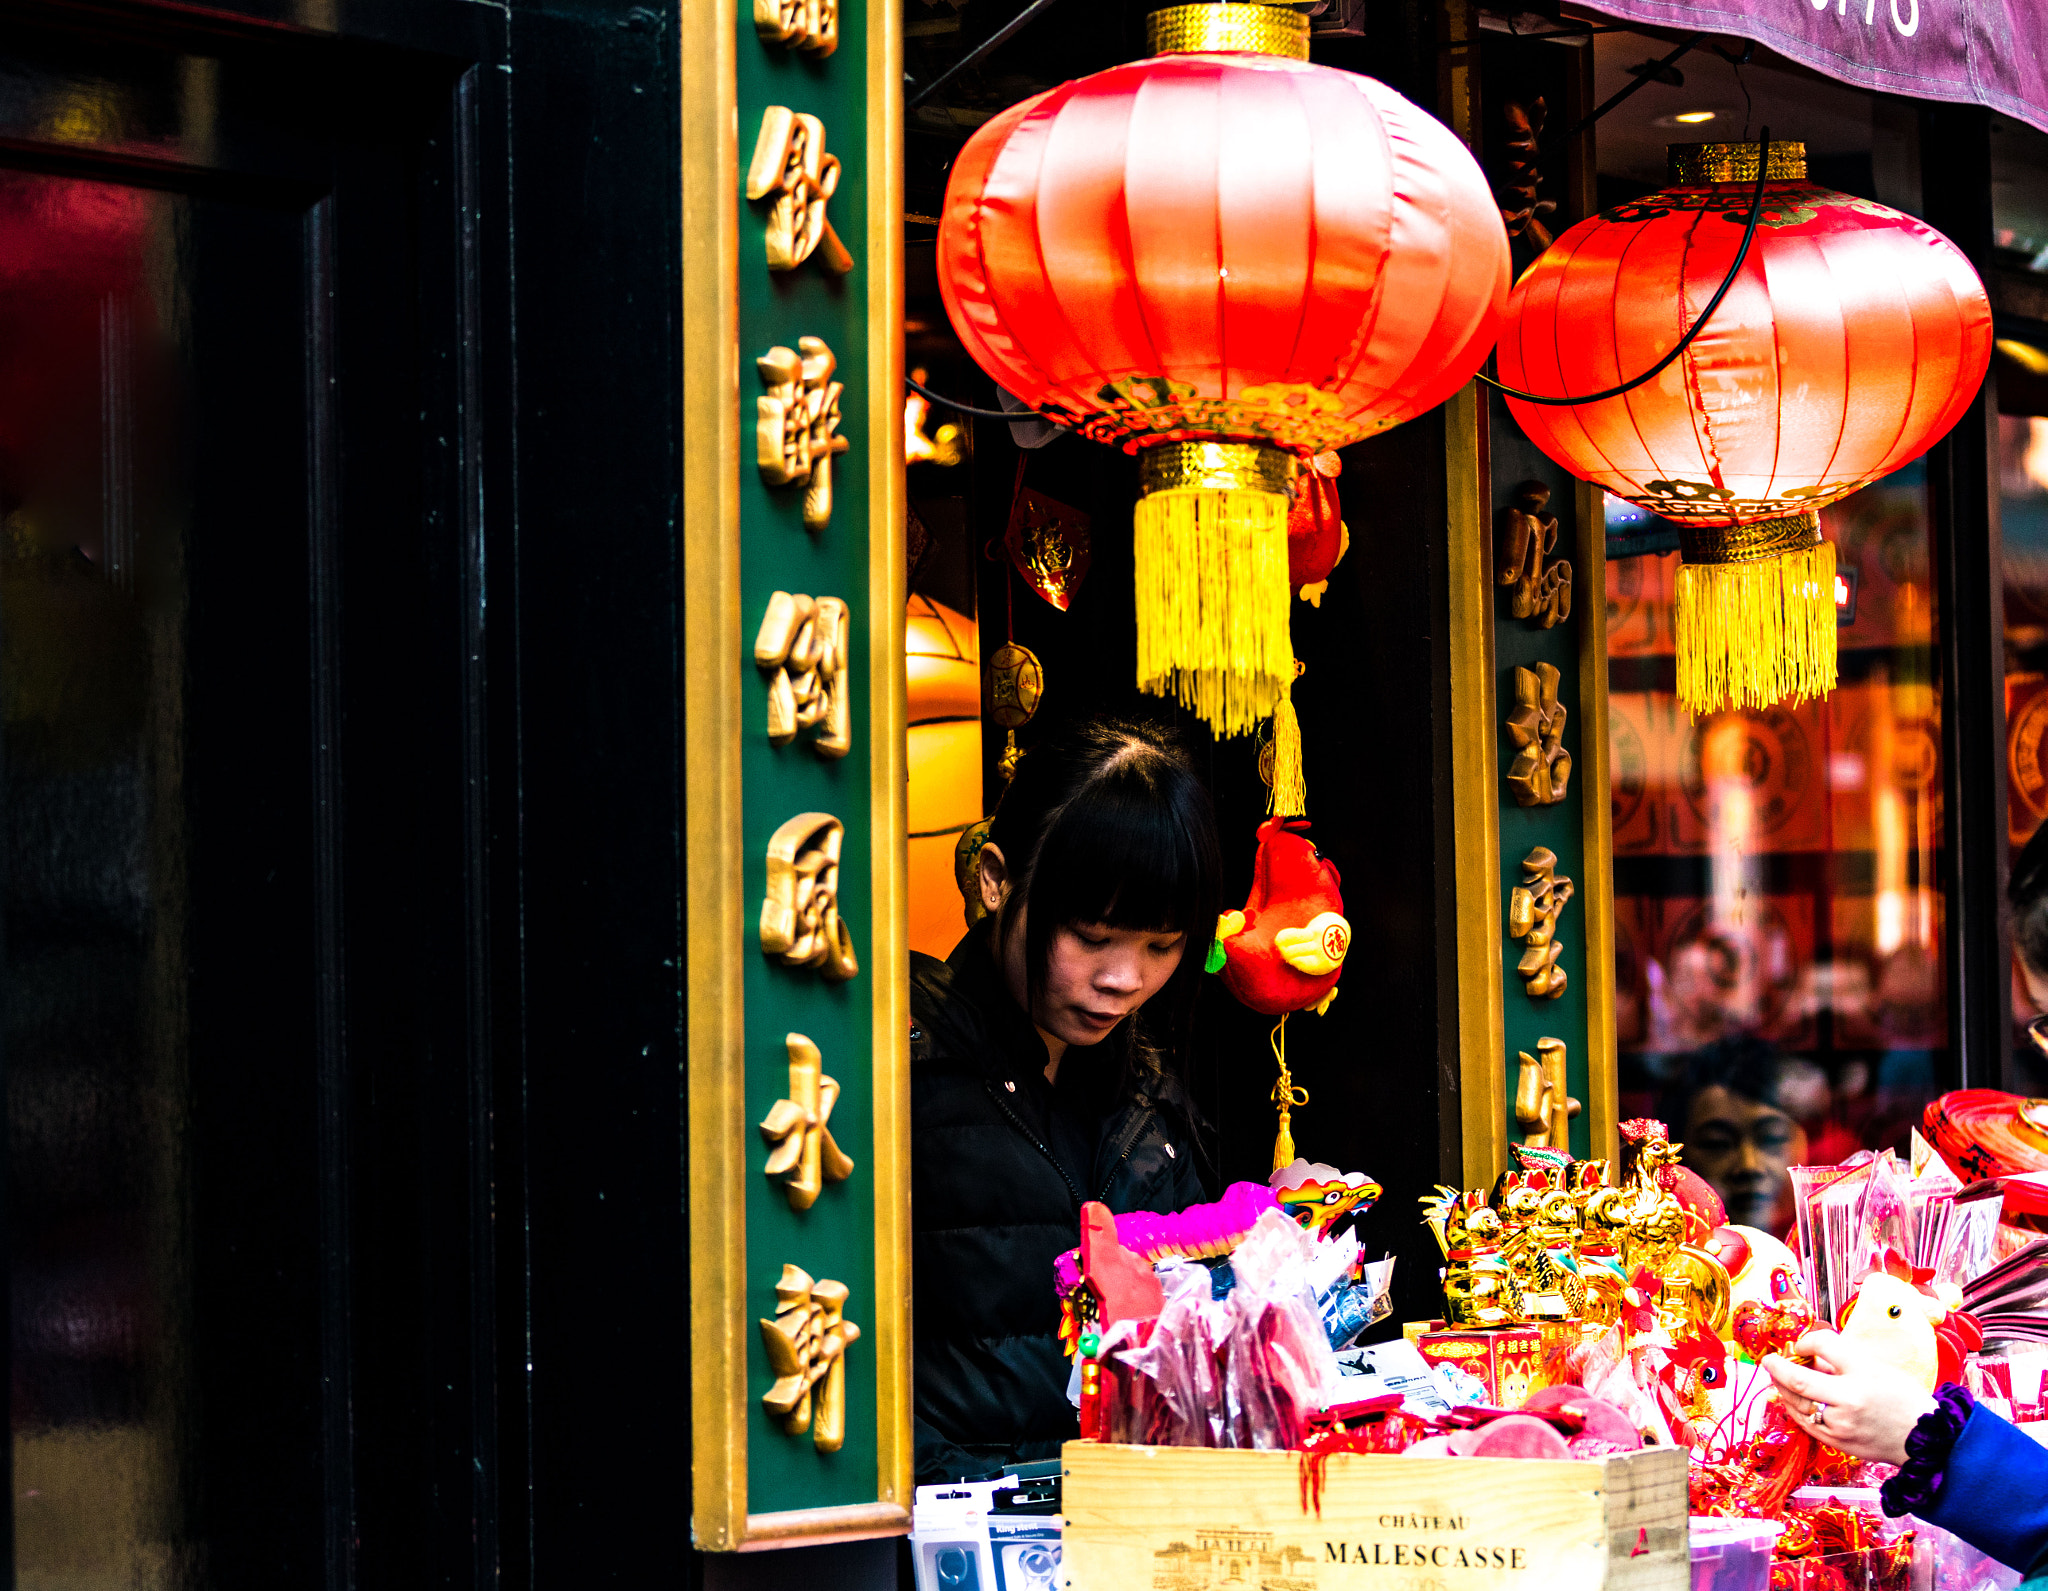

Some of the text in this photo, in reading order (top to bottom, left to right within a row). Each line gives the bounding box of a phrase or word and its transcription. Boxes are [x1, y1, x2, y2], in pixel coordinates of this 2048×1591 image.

[1326, 928, 1346, 957] 福
[1378, 1512, 1471, 1531] CHÂTEAU
[1324, 1542, 1527, 1570] MALESCASSE
